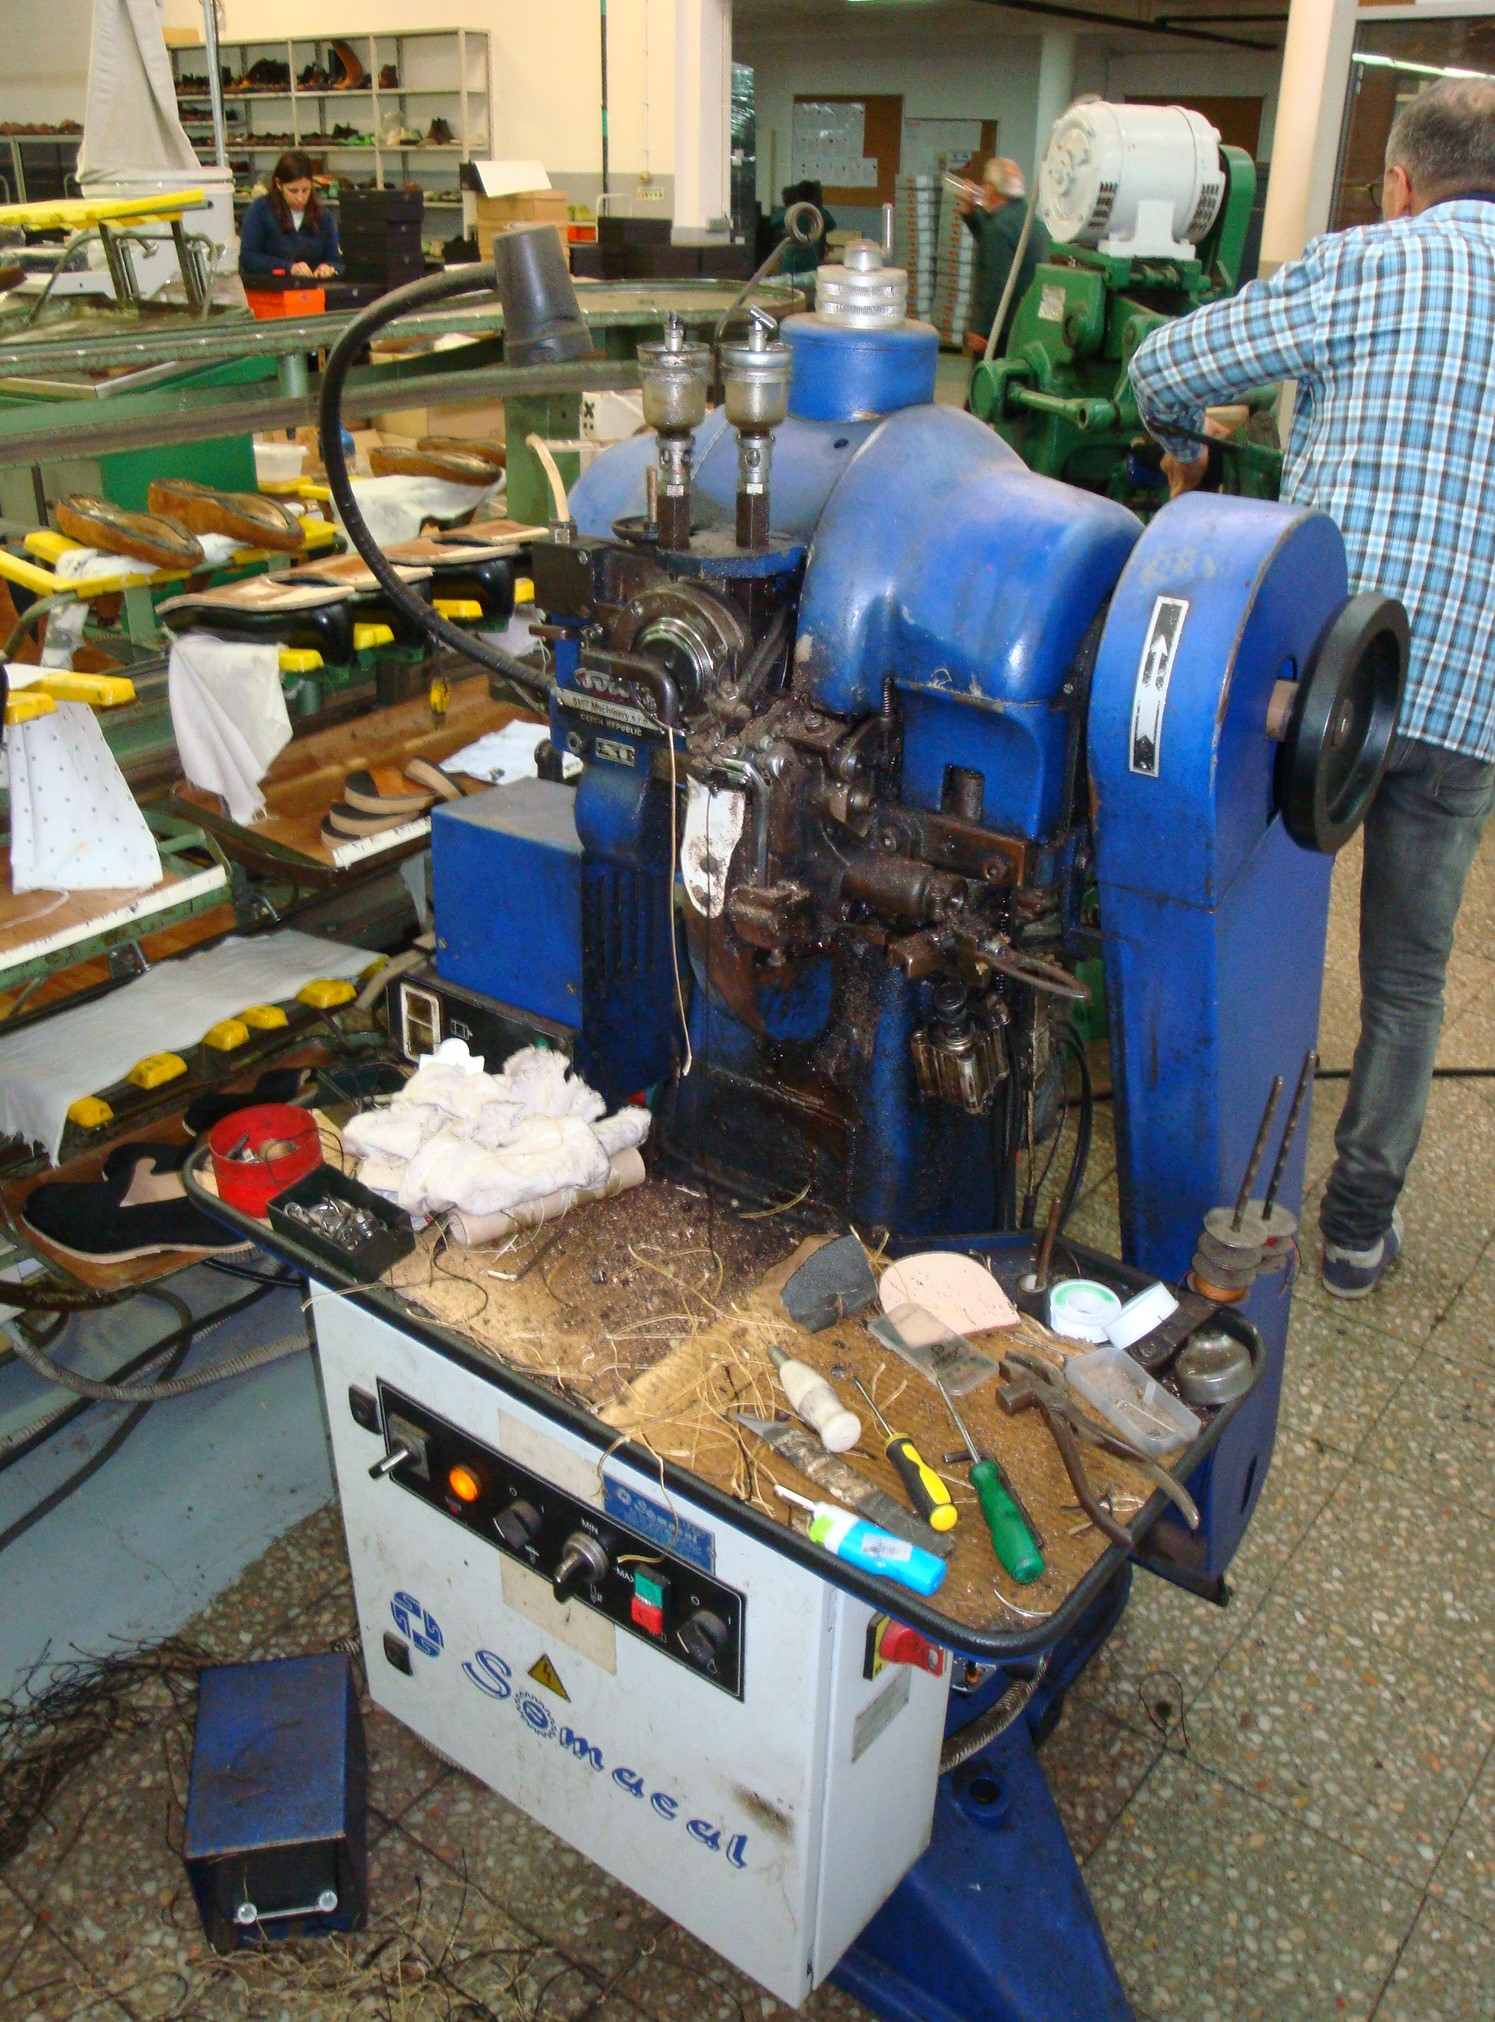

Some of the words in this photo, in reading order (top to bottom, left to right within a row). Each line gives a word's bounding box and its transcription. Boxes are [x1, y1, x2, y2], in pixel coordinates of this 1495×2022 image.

[591, 701, 630, 722] Machinery
[606, 720, 642, 736] REPUBLIC
[580, 1517, 599, 1535] MIN
[461, 1649, 749, 1870] Semacal
